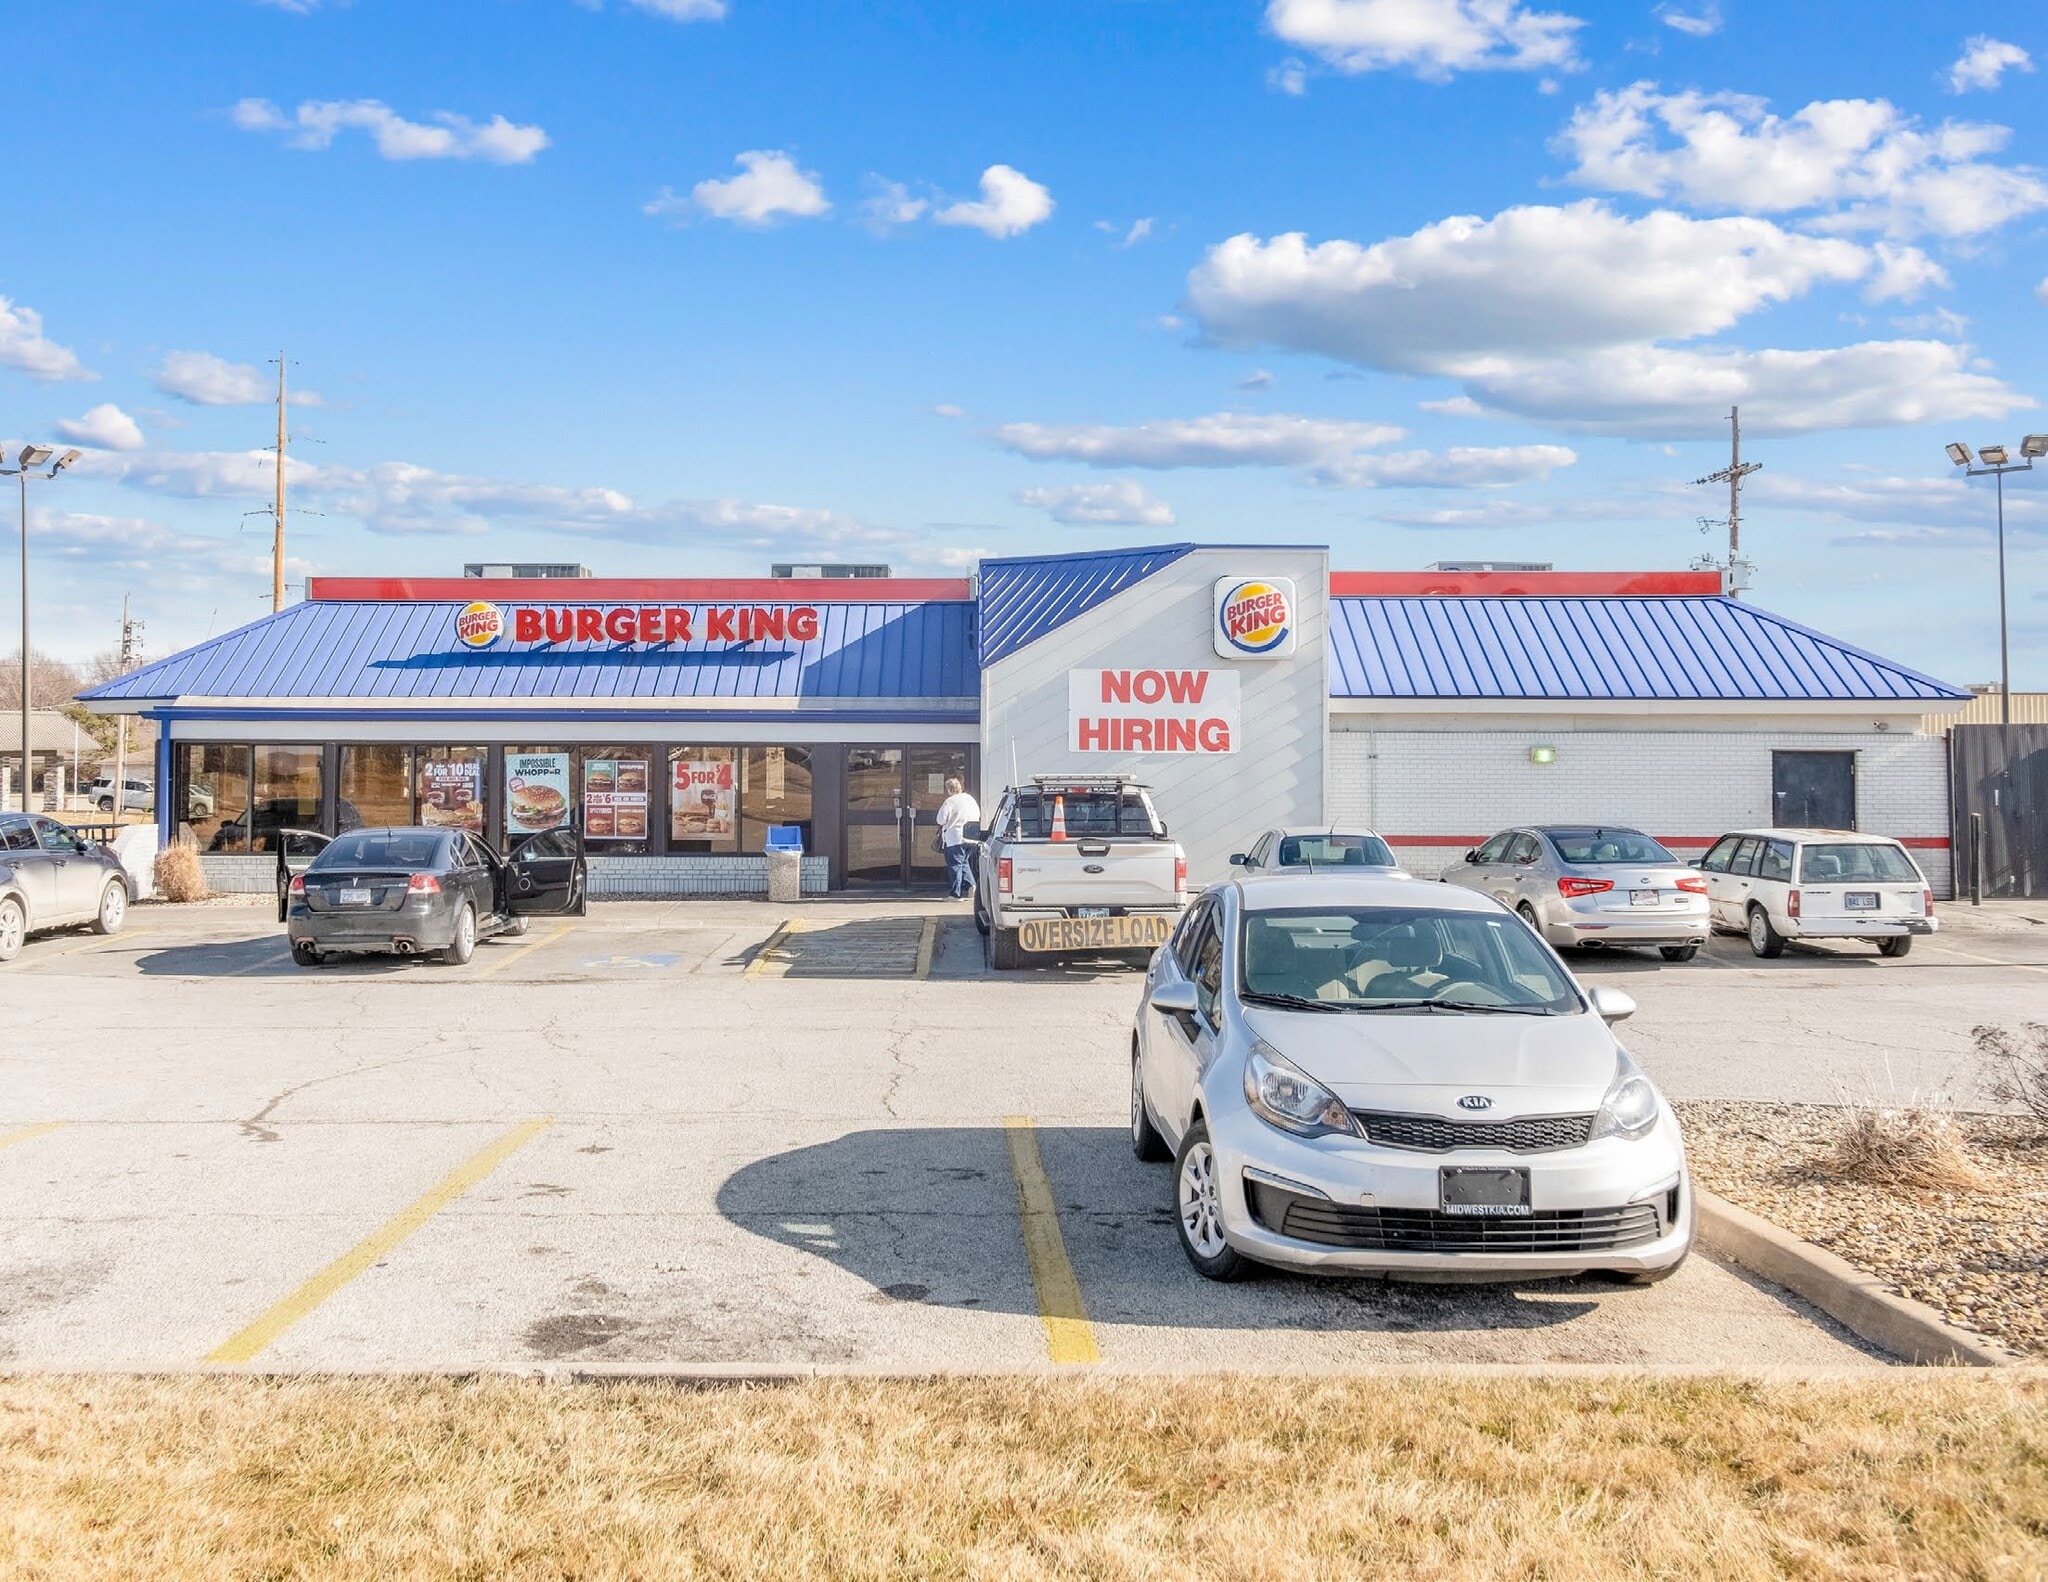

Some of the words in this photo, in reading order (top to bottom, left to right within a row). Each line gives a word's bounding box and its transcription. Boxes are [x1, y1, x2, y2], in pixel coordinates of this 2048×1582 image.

[1227, 592, 1283, 620] BURGER
[459, 611, 497, 626] BURGER
[516, 608, 692, 643] BURGER
[707, 607, 818, 642] KING
[1229, 605, 1286, 639] KING
[459, 619, 499, 639] KING
[1101, 670, 1209, 704] NOW
[1079, 718, 1230, 752] HIRING
[425, 763, 433, 776] 2
[433, 768, 448, 776] FOR
[515, 768, 561, 776] WHOPPR
[519, 758, 556, 768] IMPOSSIBLE
[674, 763, 691, 790] 5
[691, 771, 715, 784] FOR
[586, 794, 593, 803] 2
[1023, 918, 1114, 949] OVERSIZE
[1119, 917, 1169, 944] LOAD
[1462, 1097, 1491, 1107] KIA
[1446, 1205, 1530, 1215] MIDWESTKIA.COM
